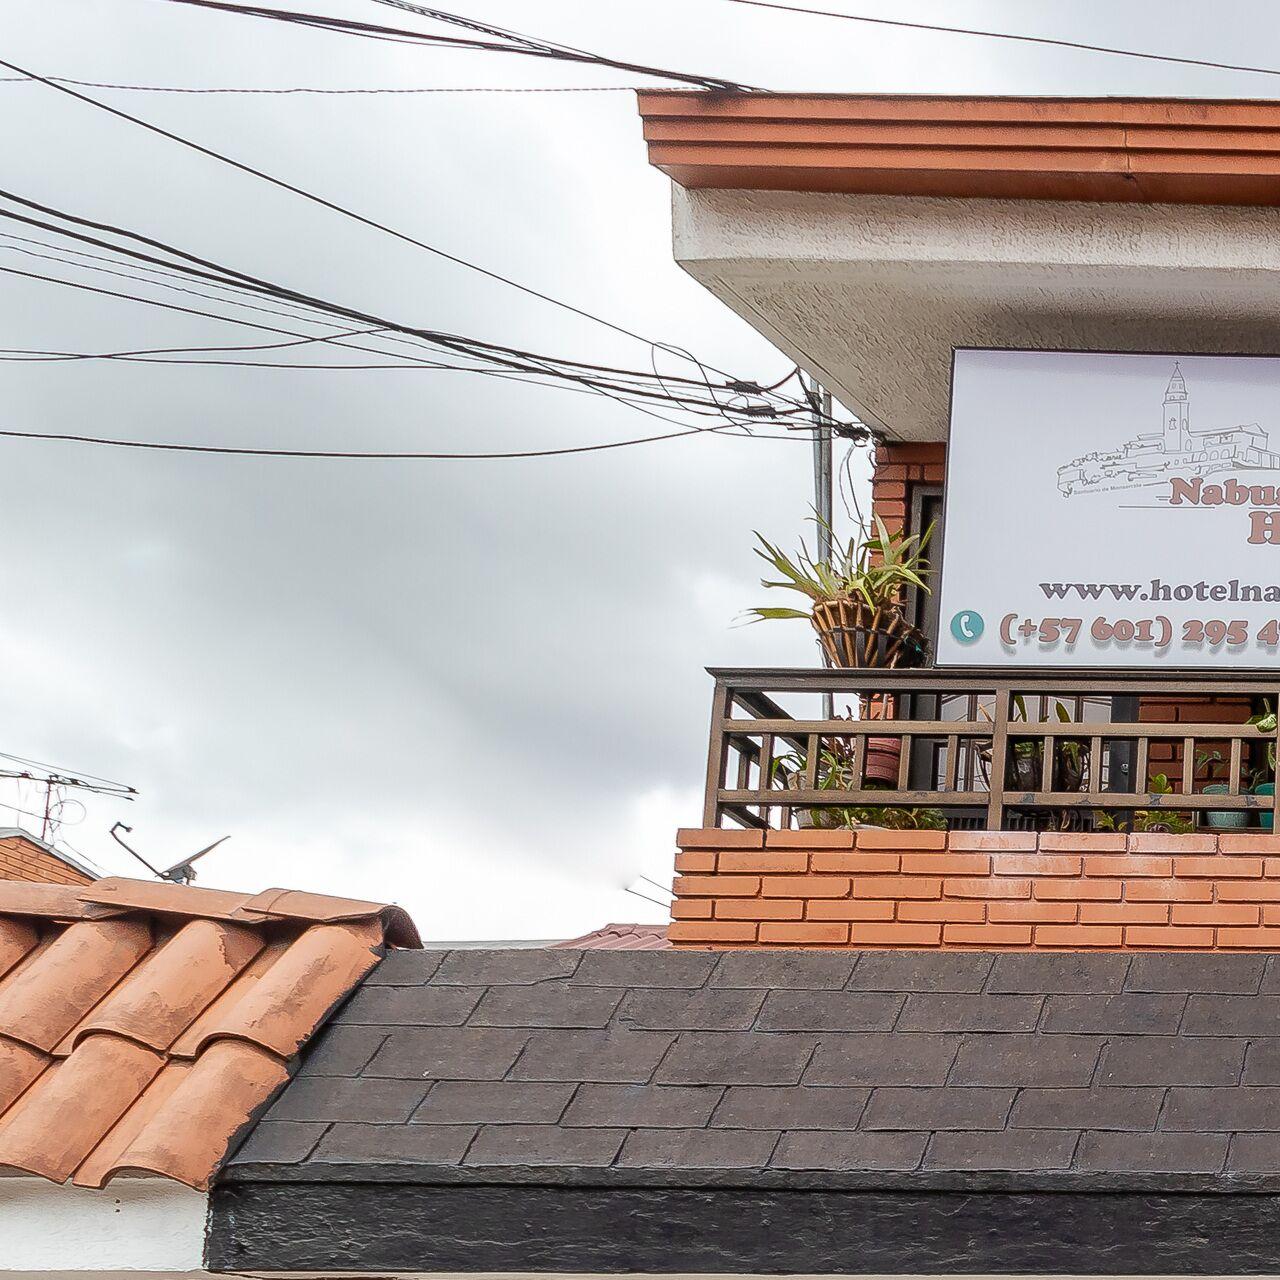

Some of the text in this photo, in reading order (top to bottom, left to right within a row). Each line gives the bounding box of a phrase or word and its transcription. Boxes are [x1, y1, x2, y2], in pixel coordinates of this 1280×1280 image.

[999, 613, 1083, 645] (+57
[1090, 615, 1173, 647] 601)
[1181, 619, 1249, 645] 295
